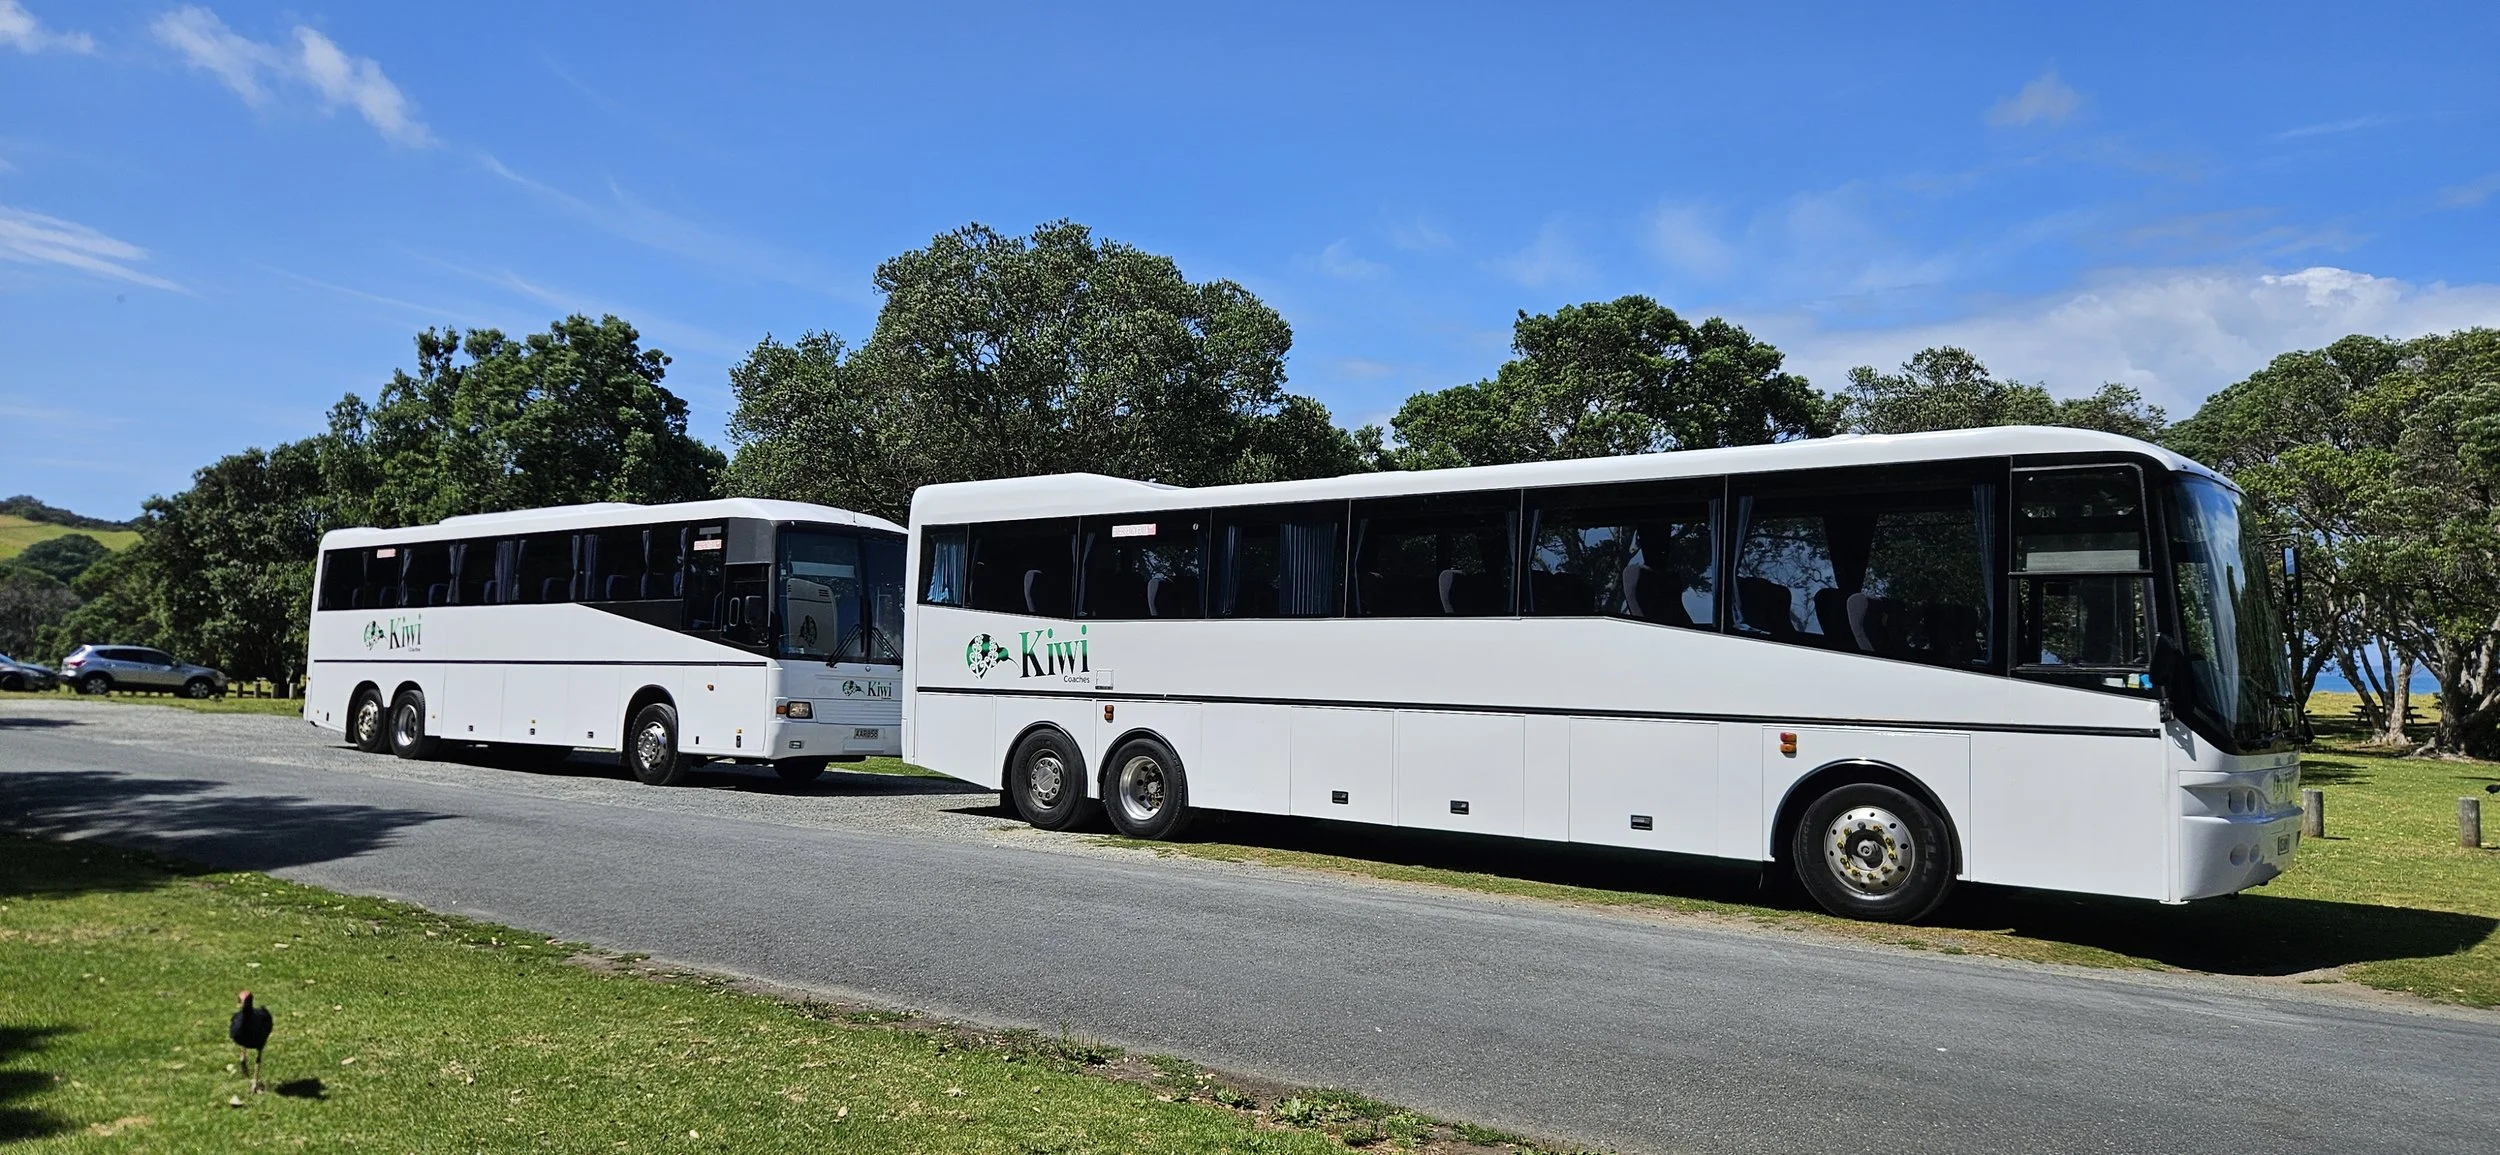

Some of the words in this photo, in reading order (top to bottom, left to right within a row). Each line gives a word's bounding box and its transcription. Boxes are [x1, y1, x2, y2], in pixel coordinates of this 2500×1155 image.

[389, 613, 421, 650] Kiwi
[1019, 624, 1090, 678] Kiwi
[867, 681, 892, 697] Kiwi
[1063, 675, 1090, 684] Coaches
